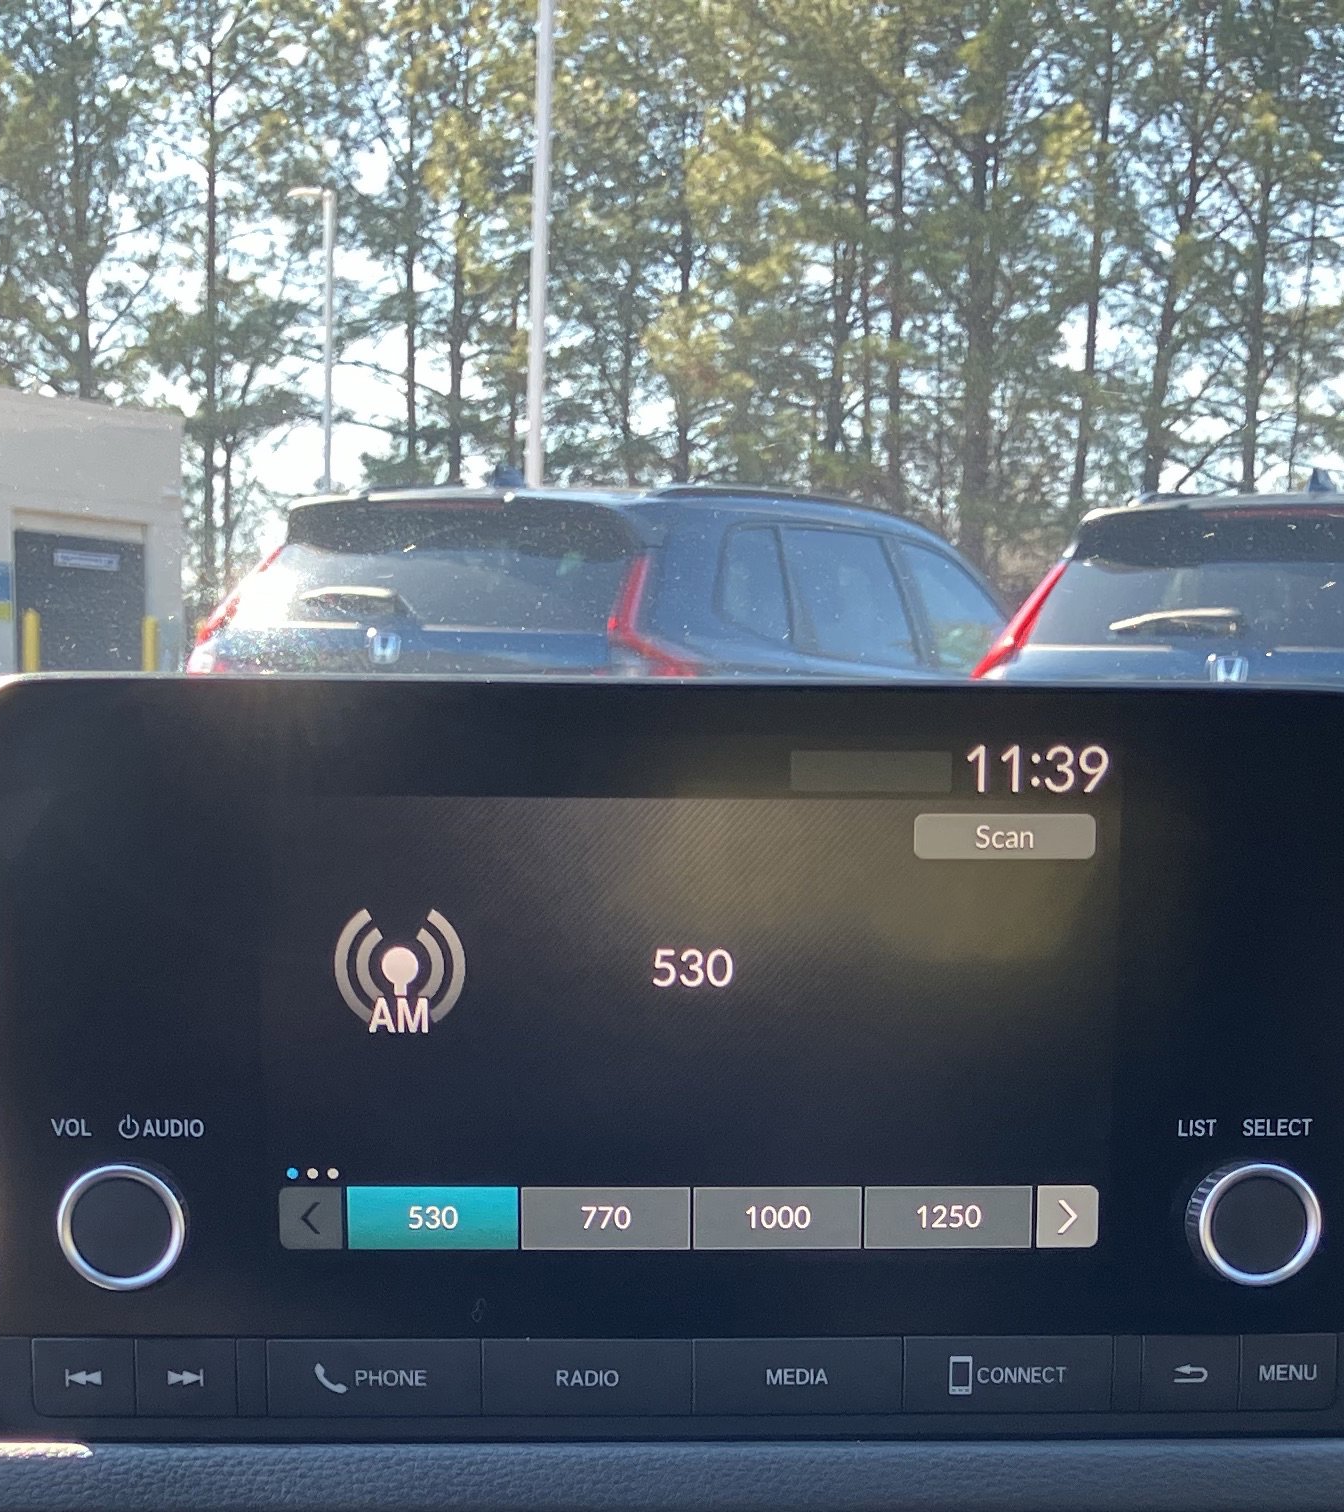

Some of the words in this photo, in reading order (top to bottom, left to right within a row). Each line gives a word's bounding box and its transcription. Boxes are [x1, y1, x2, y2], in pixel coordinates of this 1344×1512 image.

[966, 744, 1110, 793] 11:39
[975, 824, 1034, 849] Scan
[652, 948, 734, 988] 530
[368, 997, 429, 1033] AM
[51, 1118, 92, 1137] VOL
[142, 1118, 205, 1138] AUDIO
[1177, 1119, 1217, 1137] LIST
[1242, 1118, 1313, 1137] SELECT
[408, 1205, 459, 1230] 530
[580, 1205, 631, 1230] 770
[745, 1204, 811, 1230] 1000
[916, 1204, 982, 1229] 1250
[355, 1369, 428, 1387] PHONE
[556, 1369, 619, 1387] RADIO
[766, 1368, 828, 1385] MEDIA
[976, 1366, 1067, 1385] CONNECT
[1259, 1364, 1318, 1382] MENU
